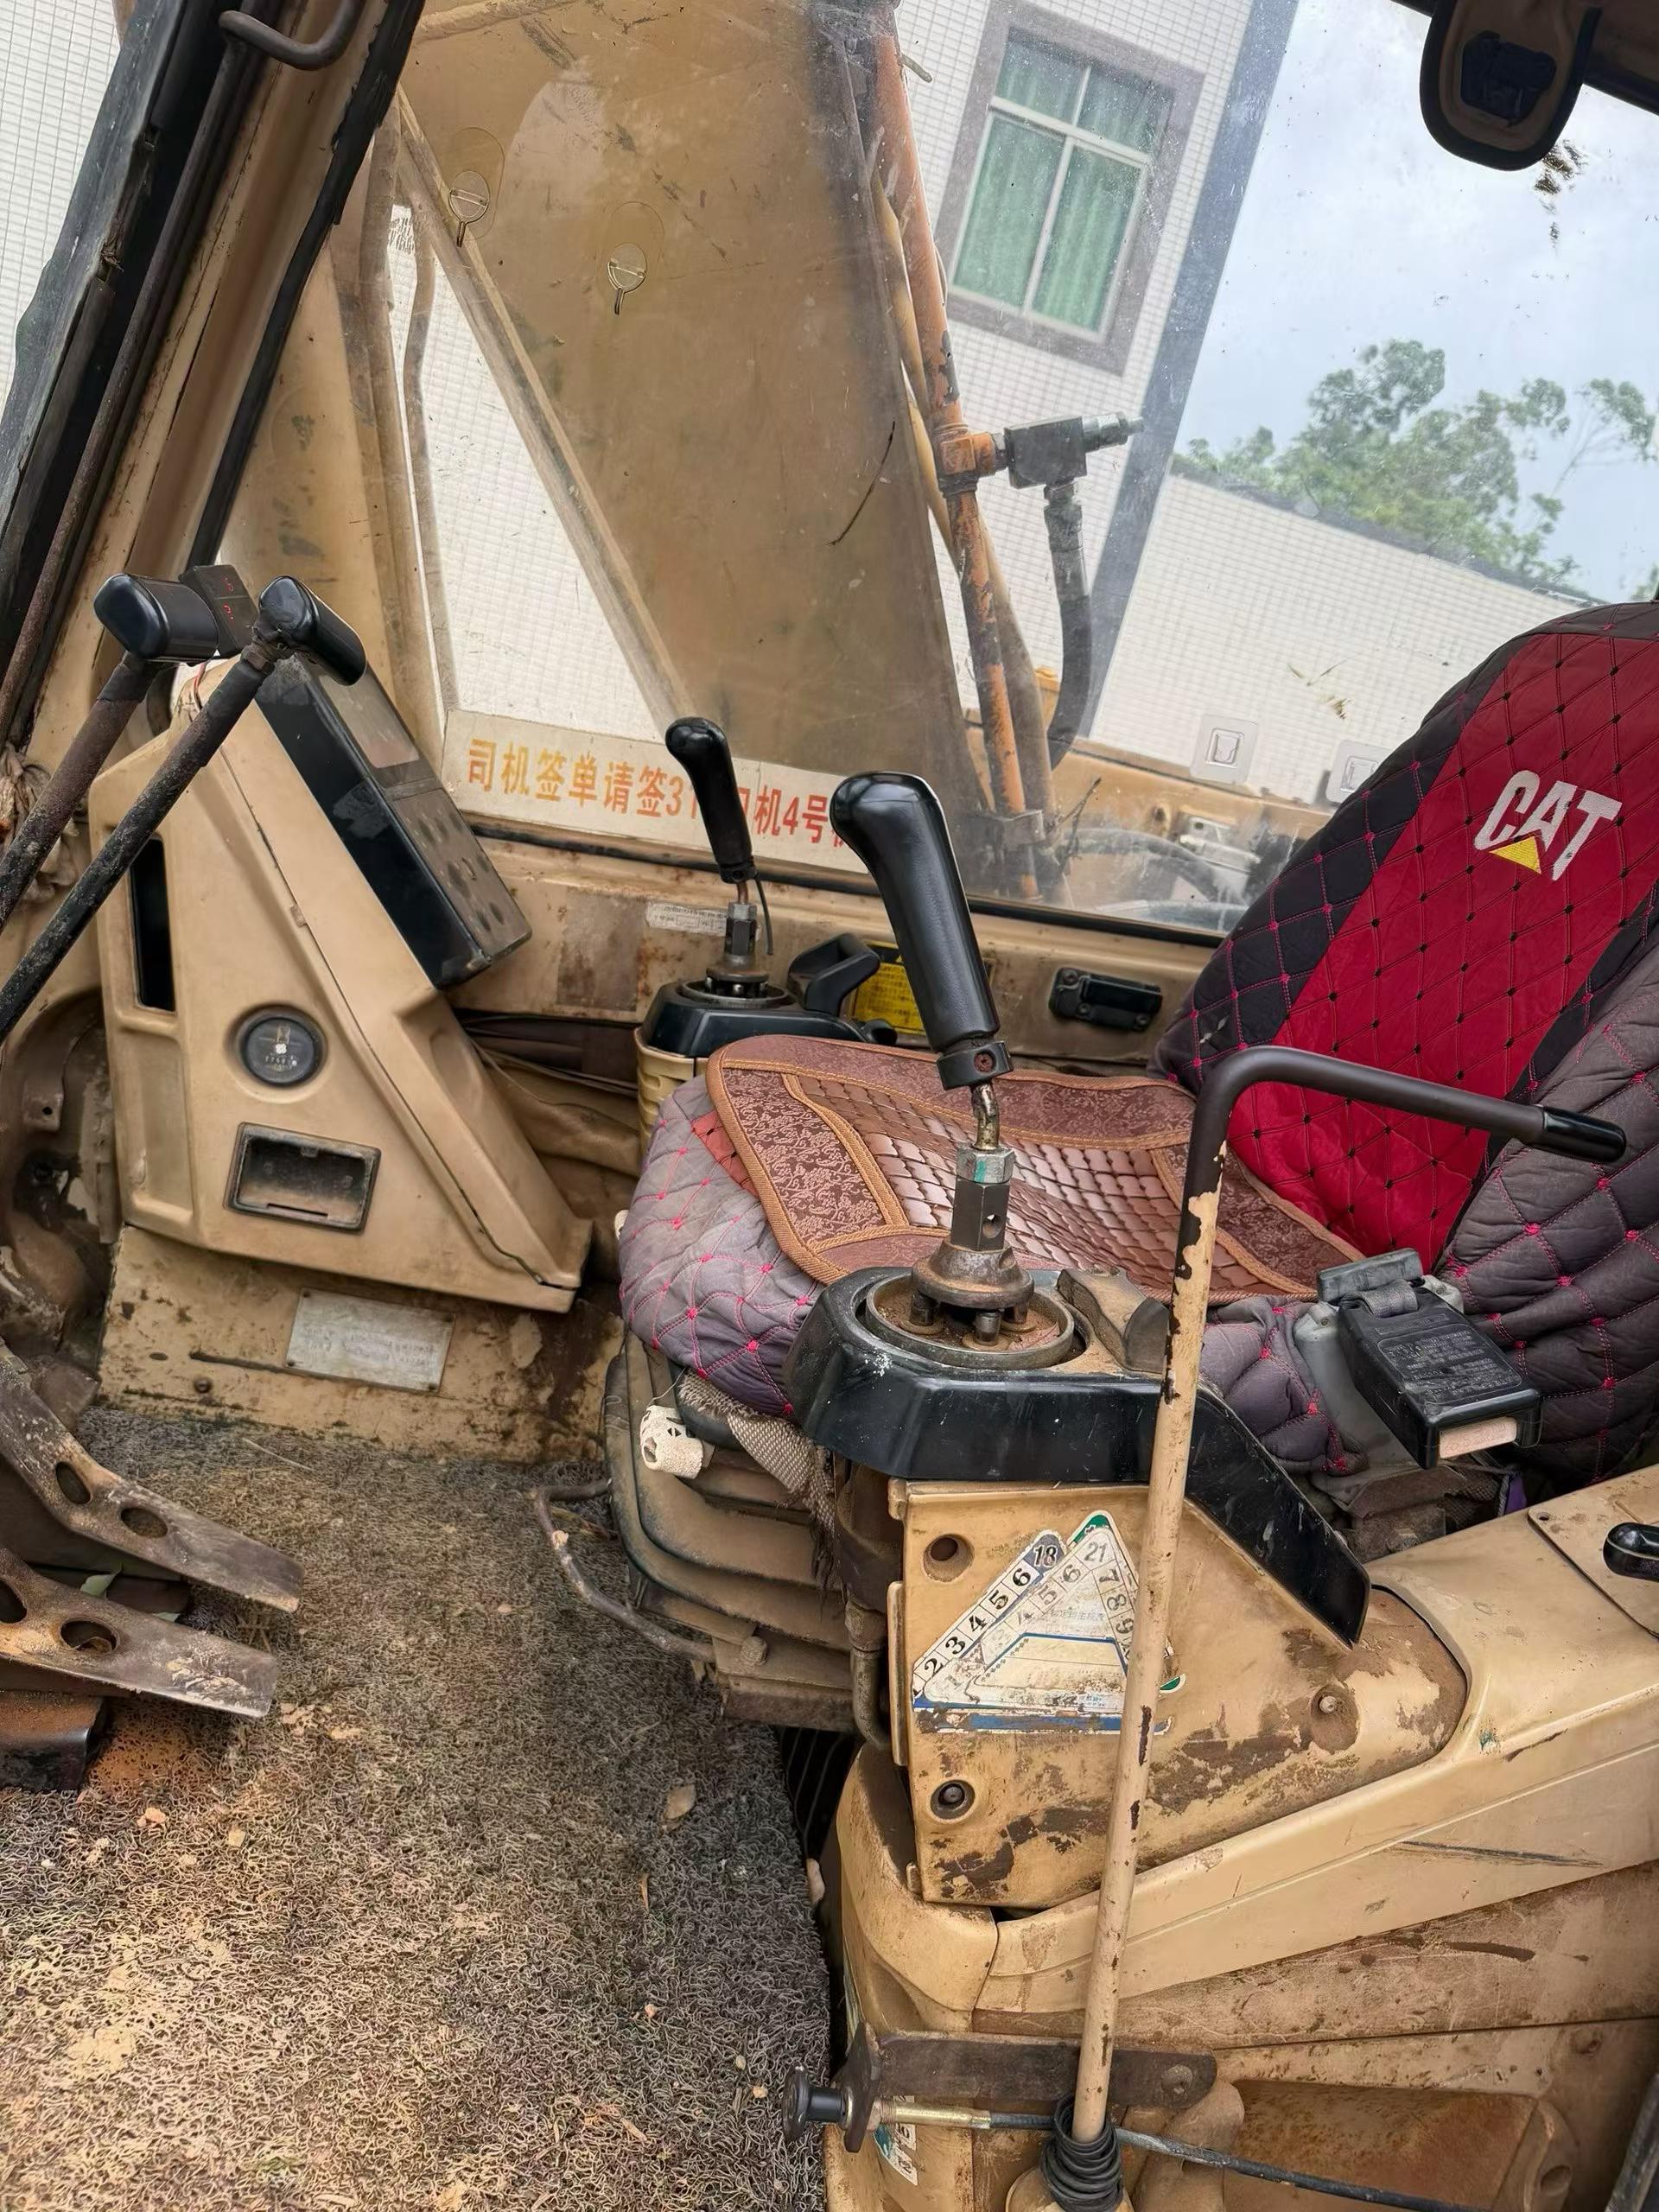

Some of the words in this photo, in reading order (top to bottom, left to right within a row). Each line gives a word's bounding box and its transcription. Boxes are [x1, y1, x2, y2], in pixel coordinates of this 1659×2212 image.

[1474, 770, 1623, 881] CAT
[1033, 1545, 1058, 1567] 18
[1084, 1541, 1108, 1563] 21
[1038, 1584, 1058, 1605] 5
[1062, 1564, 1082, 1583] 6
[1098, 1568, 1120, 1583] 7
[1106, 1593, 1128, 1611] 8
[924, 1657, 944, 1676] 2
[944, 1636, 966, 1655] 3
[969, 1615, 988, 1632] 4
[988, 1590, 1009, 1610] 5
[1012, 1567, 1032, 1587] 6
